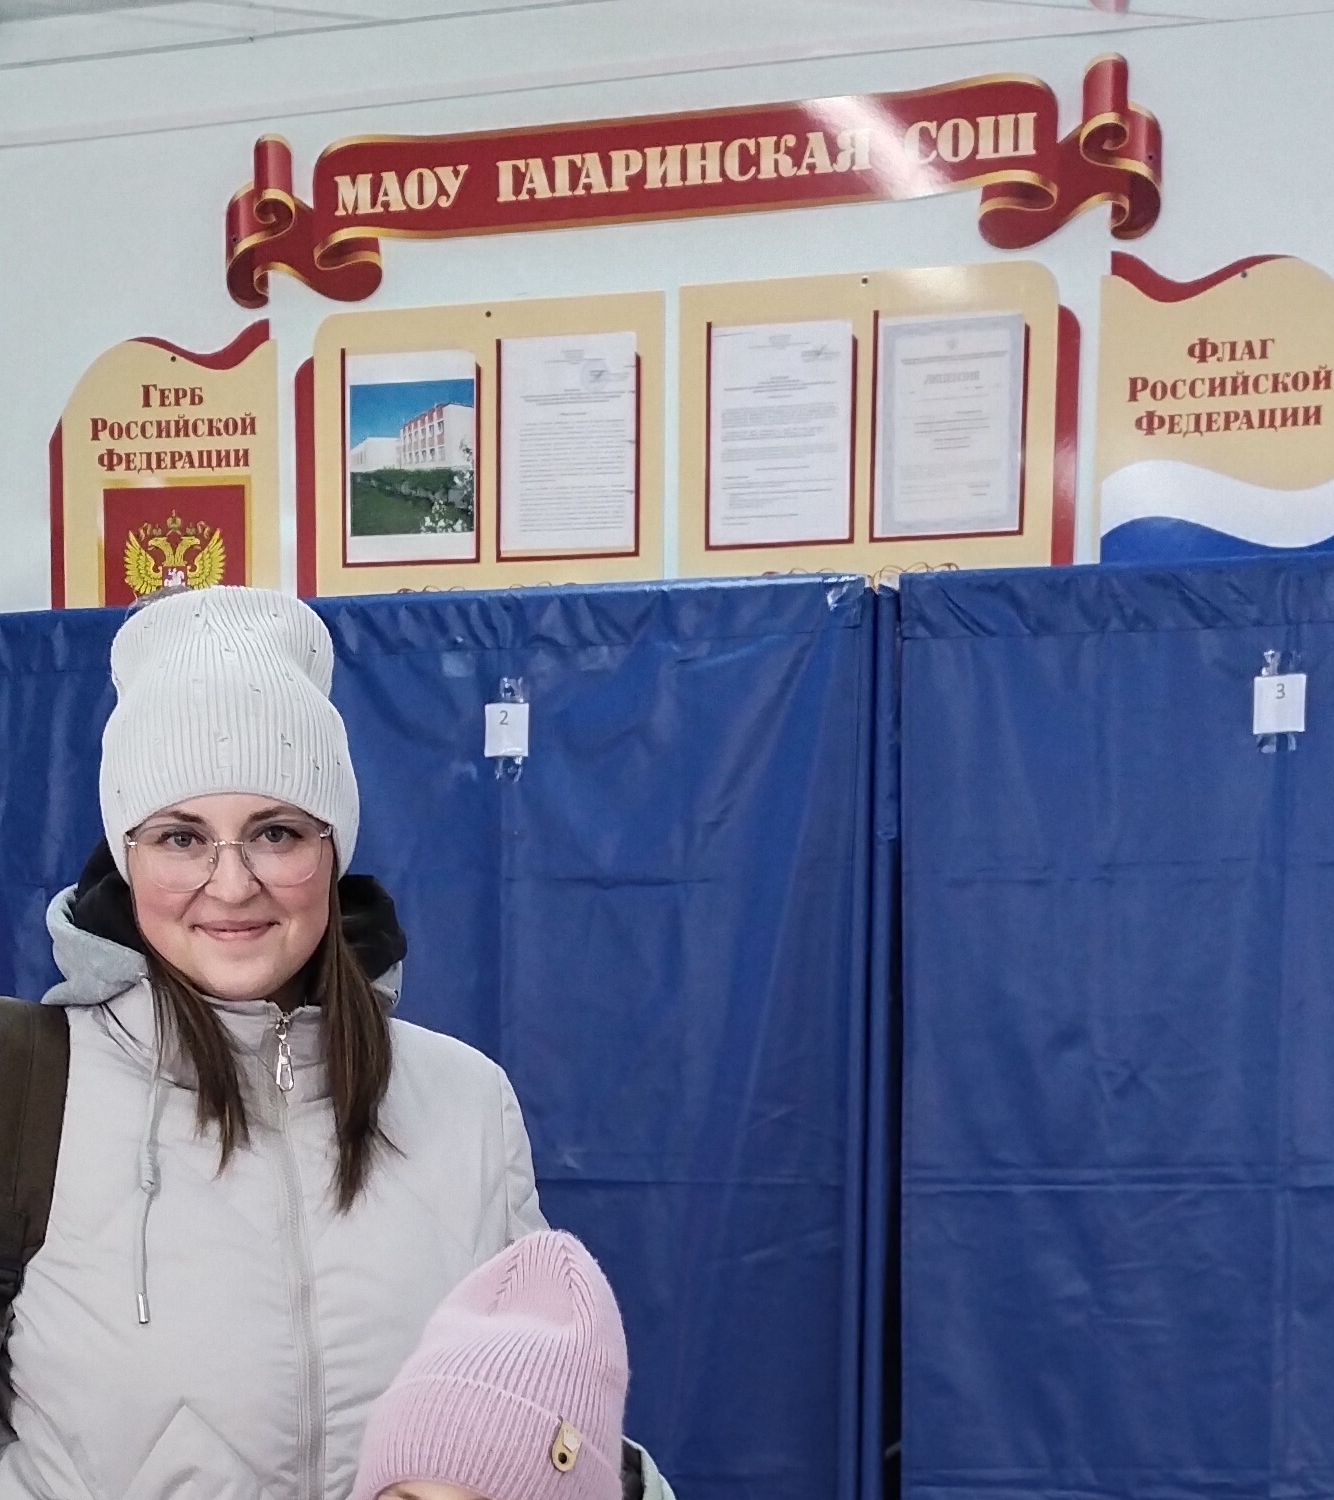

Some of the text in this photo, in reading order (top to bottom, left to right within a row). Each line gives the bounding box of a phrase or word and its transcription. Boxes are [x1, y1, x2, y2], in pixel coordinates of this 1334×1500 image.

[333, 111, 1038, 217] МАОУ ГАГАРИНСКАЯ СОШ
[1275, 682, 1286, 700] 3
[499, 709, 509, 726] 2
